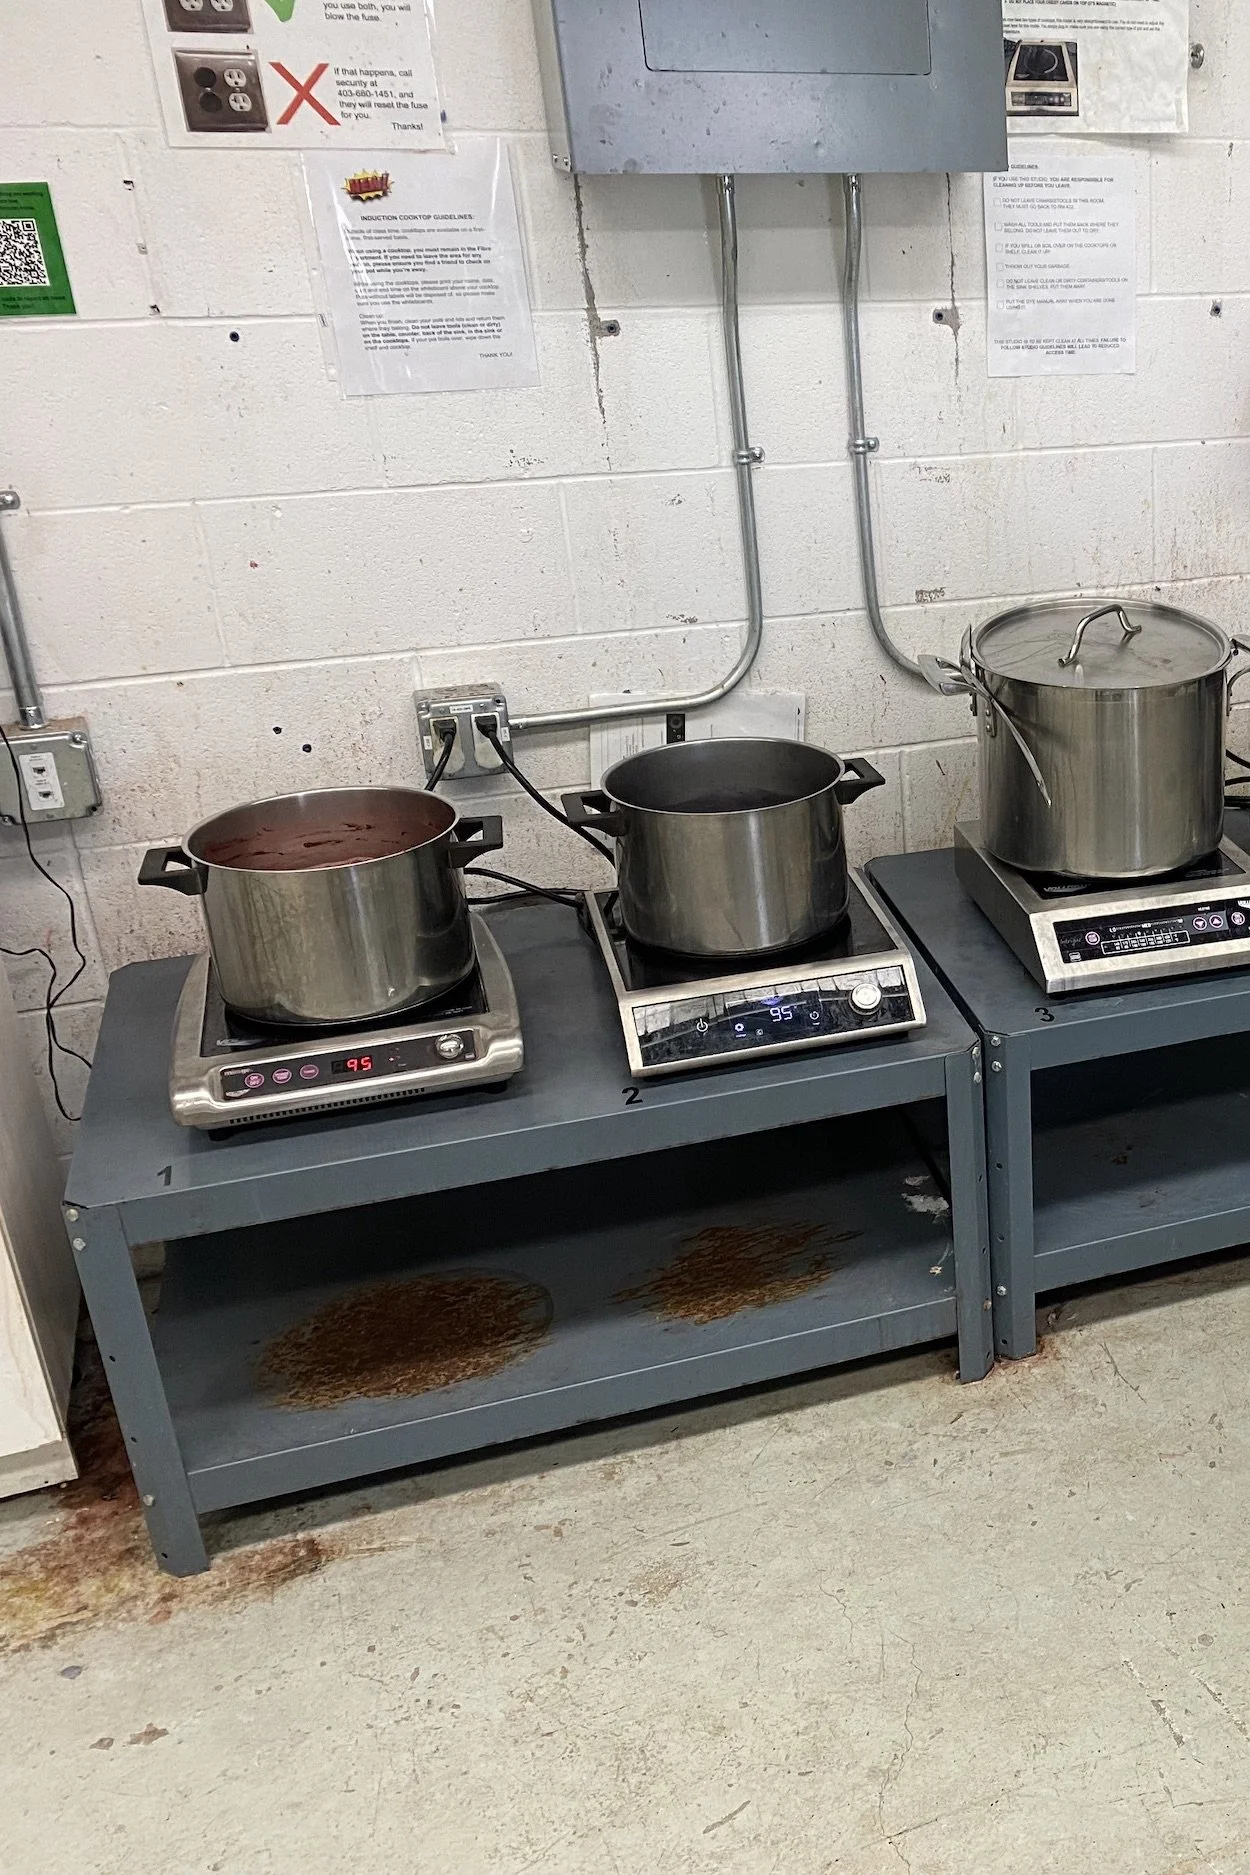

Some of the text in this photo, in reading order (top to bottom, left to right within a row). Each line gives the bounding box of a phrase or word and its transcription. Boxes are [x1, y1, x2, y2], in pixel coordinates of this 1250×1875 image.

[323, 2, 339, 10] you
[358, 3, 379, 11] both,
[325, 12, 344, 20] blow
[342, 68, 357, 76] that
[359, 68, 397, 77] happens,
[336, 79, 367, 88] security
[399, 90, 414, 98] and
[340, 101, 356, 109] they
[392, 122, 423, 131] Thanks!
[1035, 1007, 1054, 1022] 3
[621, 1086, 643, 1105] 2
[157, 1165, 172, 1186] 1
